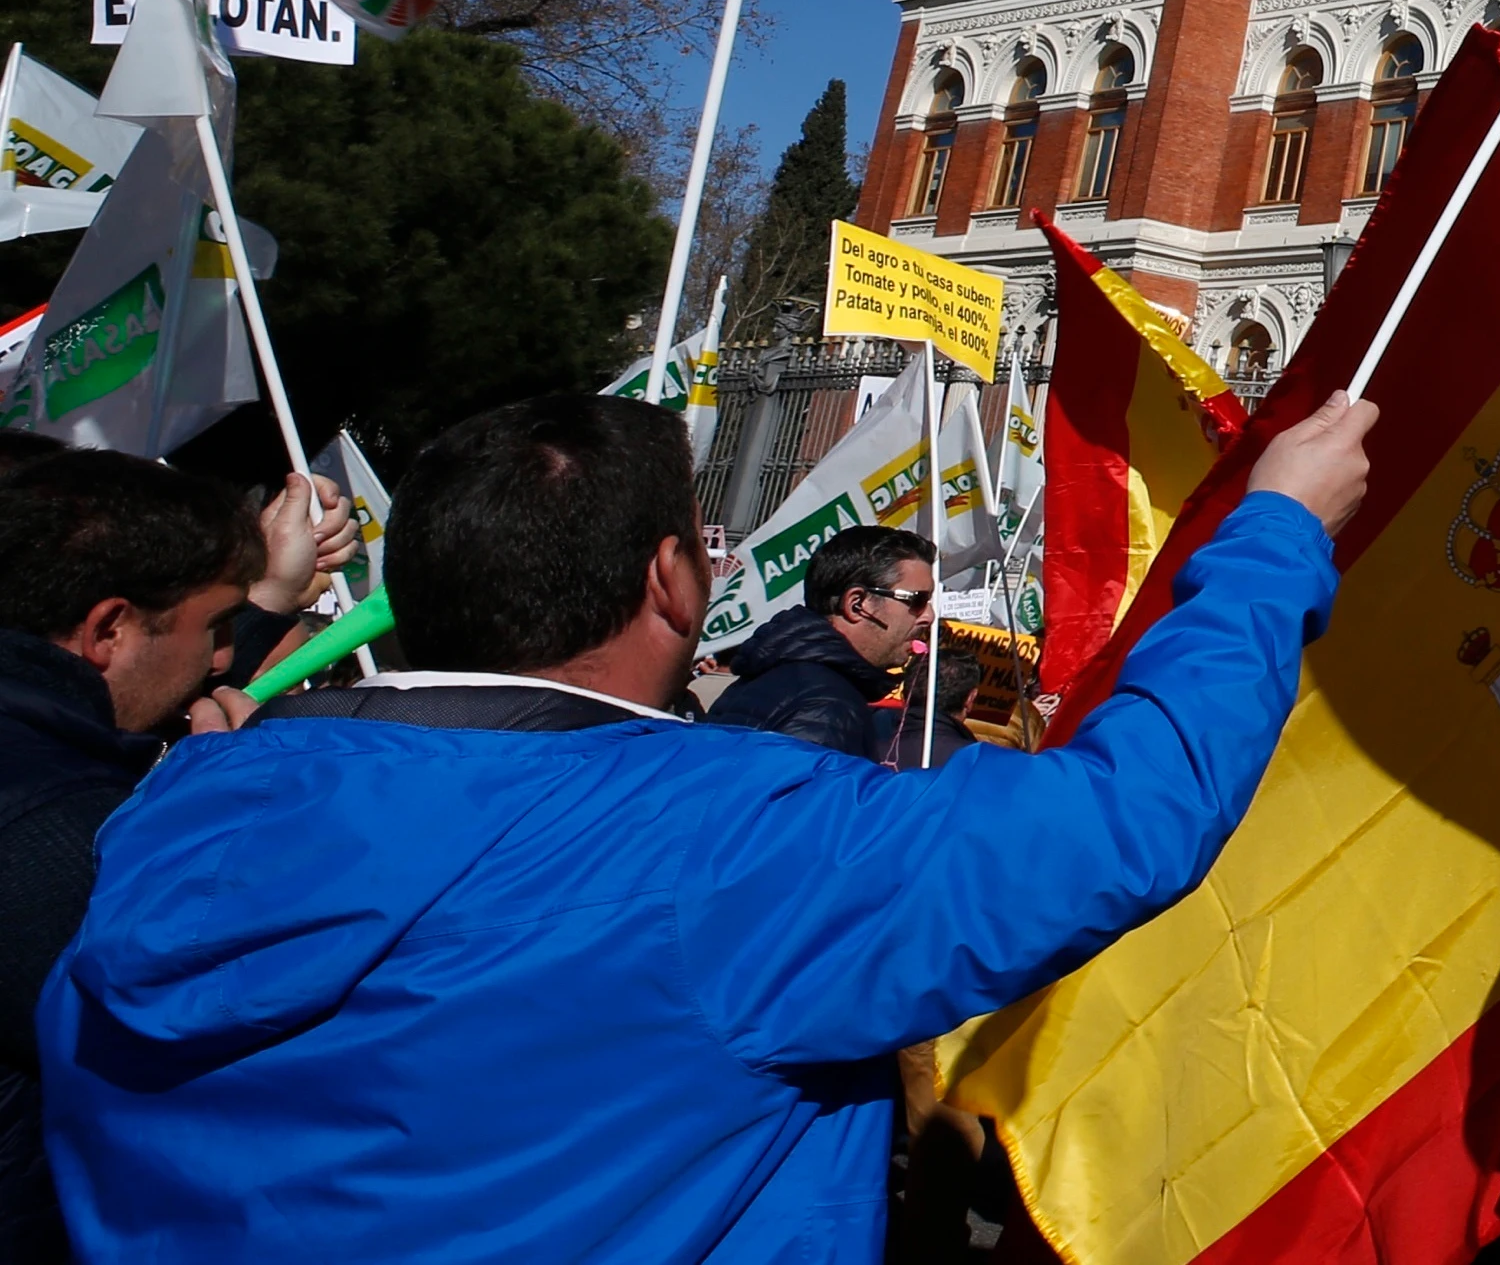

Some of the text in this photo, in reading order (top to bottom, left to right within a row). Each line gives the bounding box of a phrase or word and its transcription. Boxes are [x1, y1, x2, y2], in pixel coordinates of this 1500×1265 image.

[841, 238, 996, 311] Del agro a tu casa suben:
[844, 264, 992, 334] Tomate y pollo, el 400%.
[835, 289, 991, 361] Patata y naranja, el 800%.
